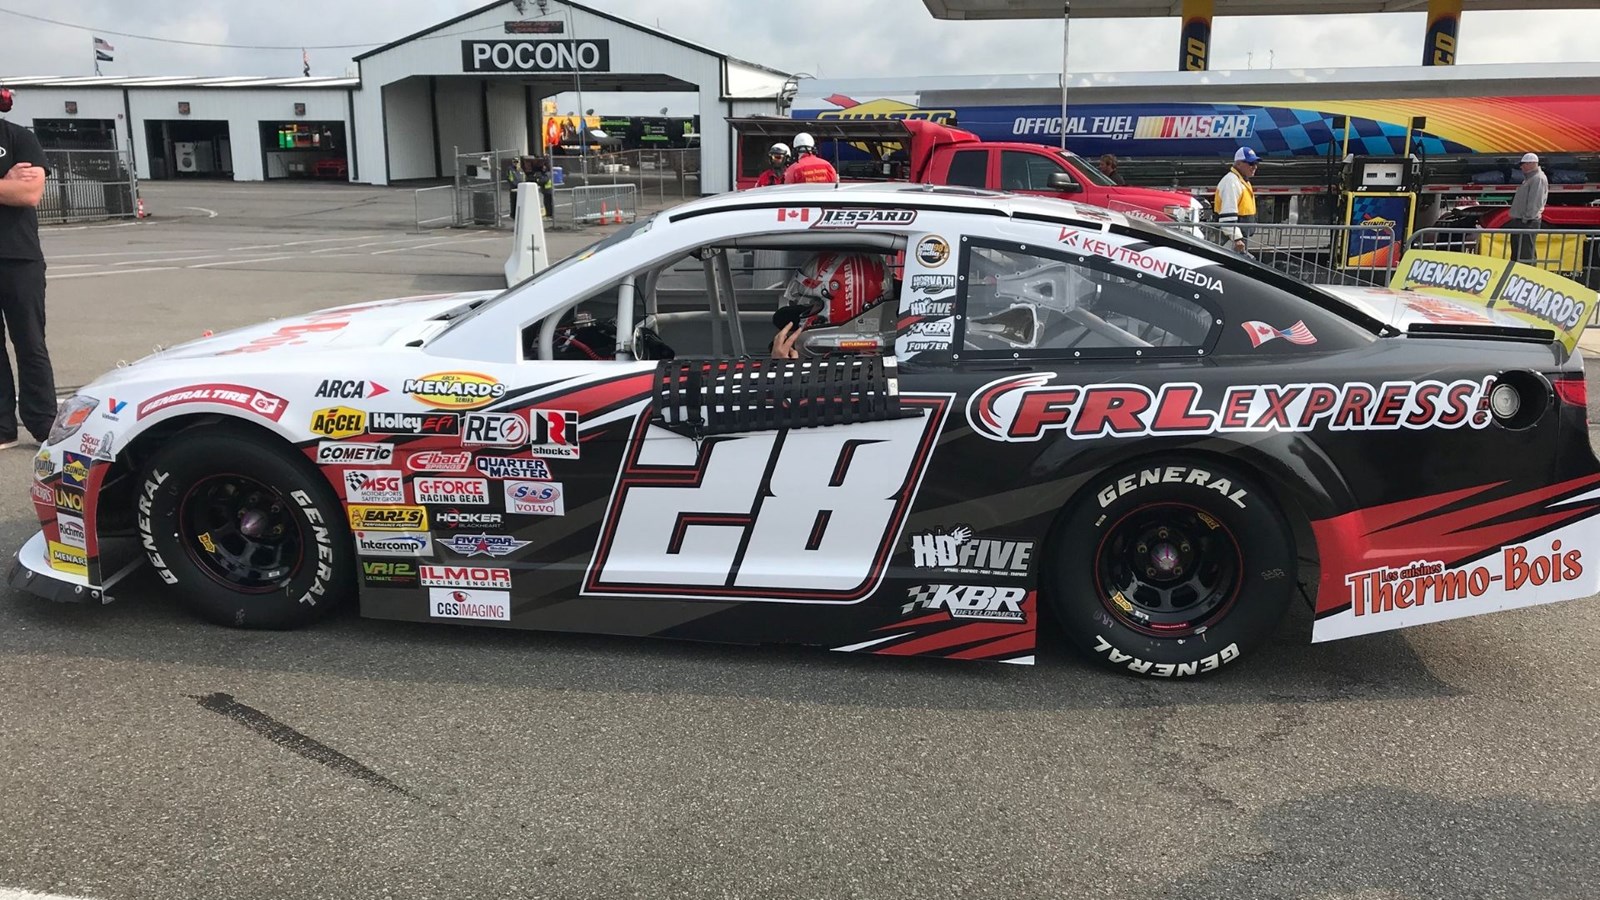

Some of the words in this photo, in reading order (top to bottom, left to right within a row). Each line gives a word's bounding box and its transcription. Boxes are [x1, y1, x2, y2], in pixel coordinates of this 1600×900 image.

[473, 42, 600, 69] POCONO
[1012, 117, 1088, 135] OFFICIAL
[1091, 116, 1134, 133] FUEL
[1171, 115, 1250, 138] NASCAR
[912, 275, 955, 287] HORVATH
[1408, 260, 1492, 292] MENARDS
[1502, 276, 1586, 328] MENARDS
[314, 380, 366, 398] ARCA
[403, 379, 505, 398] MENARDS
[141, 390, 211, 414] GENERAL
[212, 389, 250, 404] TIRE
[1006, 387, 1216, 437] FRL
[313, 411, 362, 434] ACCEL
[373, 413, 422, 433] Holley
[81, 433, 100, 446] Sioux
[80, 443, 96, 456] Chief
[533, 447, 571, 456] shocks
[410, 452, 468, 469] Eibach
[477, 457, 544, 471] QUARTER
[489, 468, 548, 478] MASTER
[361, 477, 400, 491] MSG
[514, 486, 529, 498] S
[539, 488, 553, 499] S
[1096, 466, 1248, 509] GENERAL
[420, 494, 457, 502] RACING
[459, 495, 485, 503] GEAR
[599, 405, 932, 592] 28
[364, 510, 419, 522] EARL'S
[516, 504, 554, 513] VOLVO
[138, 468, 178, 585] GENERAL
[436, 513, 502, 523] HOOKER
[290, 489, 333, 606] GENERAL
[360, 538, 419, 552] Intercomp
[454, 536, 480, 545] FIVE
[485, 537, 512, 546] STAR
[363, 562, 416, 575] VR12
[421, 567, 510, 581] ILMOR
[1381, 568, 1398, 582] Les
[1400, 563, 1442, 578] cuisines
[1348, 539, 1584, 617] Thermo-Bois
[927, 584, 1026, 612] KBR
[953, 608, 1023, 618] DEVELOPMENT
[1093, 634, 1240, 677] GENERAL
